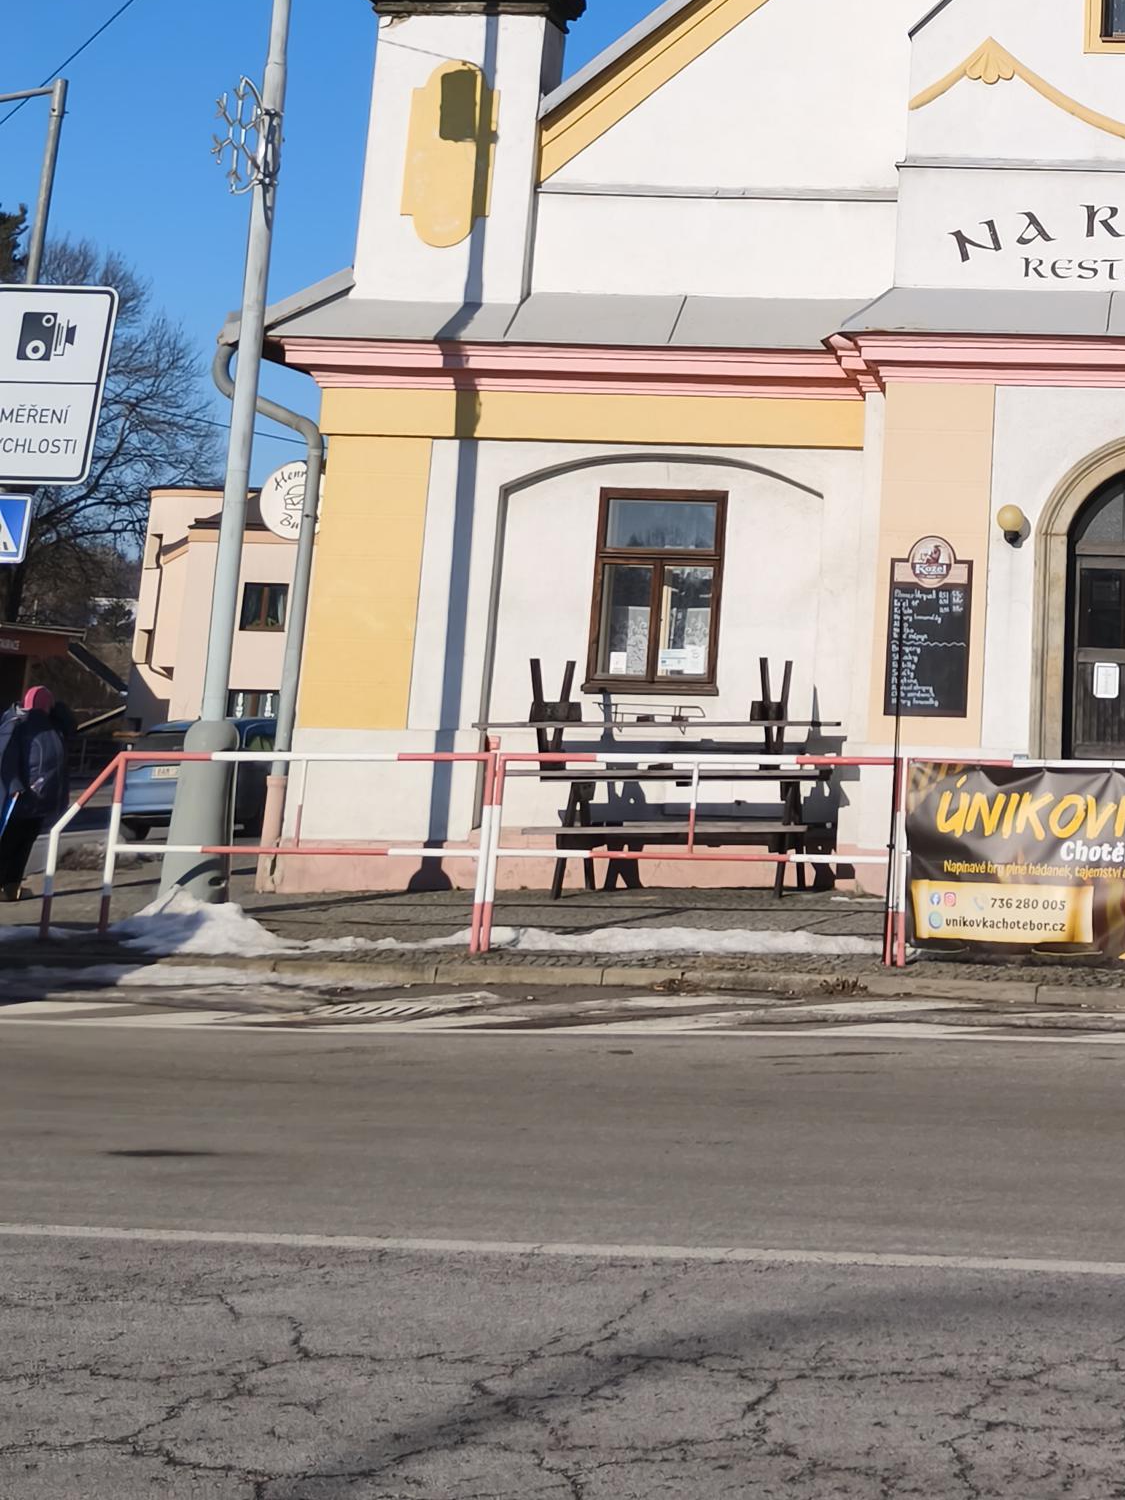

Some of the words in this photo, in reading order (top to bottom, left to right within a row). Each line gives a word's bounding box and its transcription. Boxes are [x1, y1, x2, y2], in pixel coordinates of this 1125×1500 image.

[948, 211, 1058, 262] NA
[0, 404, 71, 424] MĚŘENÍ
[0, 437, 77, 454] CHLOSTI
[915, 564, 947, 575] Kozel
[1029, 863, 1072, 878] hádanek,
[1075, 865, 1121, 880] tajemství
[991, 898, 1012, 909] 736
[1015, 898, 1038, 909] 280
[1042, 900, 1066, 911] 005
[945, 916, 1066, 932] unikovkachotebor.cz
